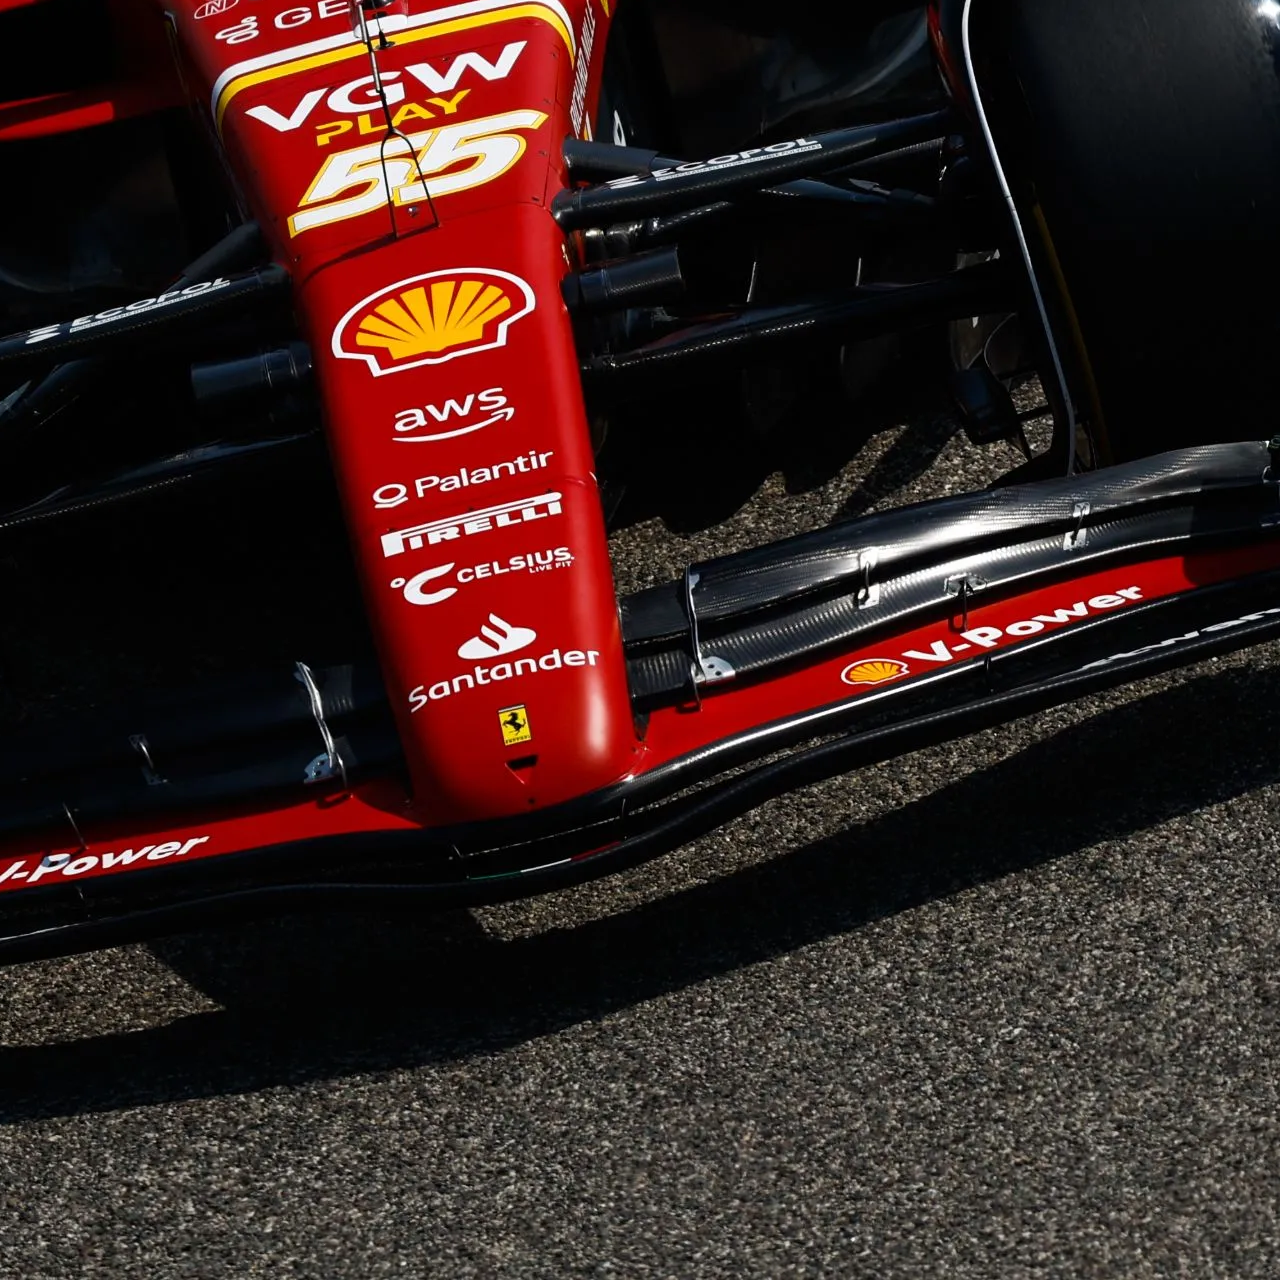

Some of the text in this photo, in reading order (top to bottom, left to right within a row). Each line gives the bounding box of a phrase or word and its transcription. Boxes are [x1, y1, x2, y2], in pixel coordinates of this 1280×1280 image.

[244, 40, 528, 133] VGW
[314, 88, 472, 147] PLAY
[286, 108, 550, 239] 55
[651, 136, 819, 179] ECOPOL
[71, 277, 231, 327] ECOPOL
[393, 386, 509, 432] aws
[414, 450, 554, 498] Palantir
[380, 491, 563, 558] PIRELLI
[528, 560, 572, 574] LIVE FIT
[901, 583, 1147, 663] V-Power
[408, 648, 600, 713] Santander
